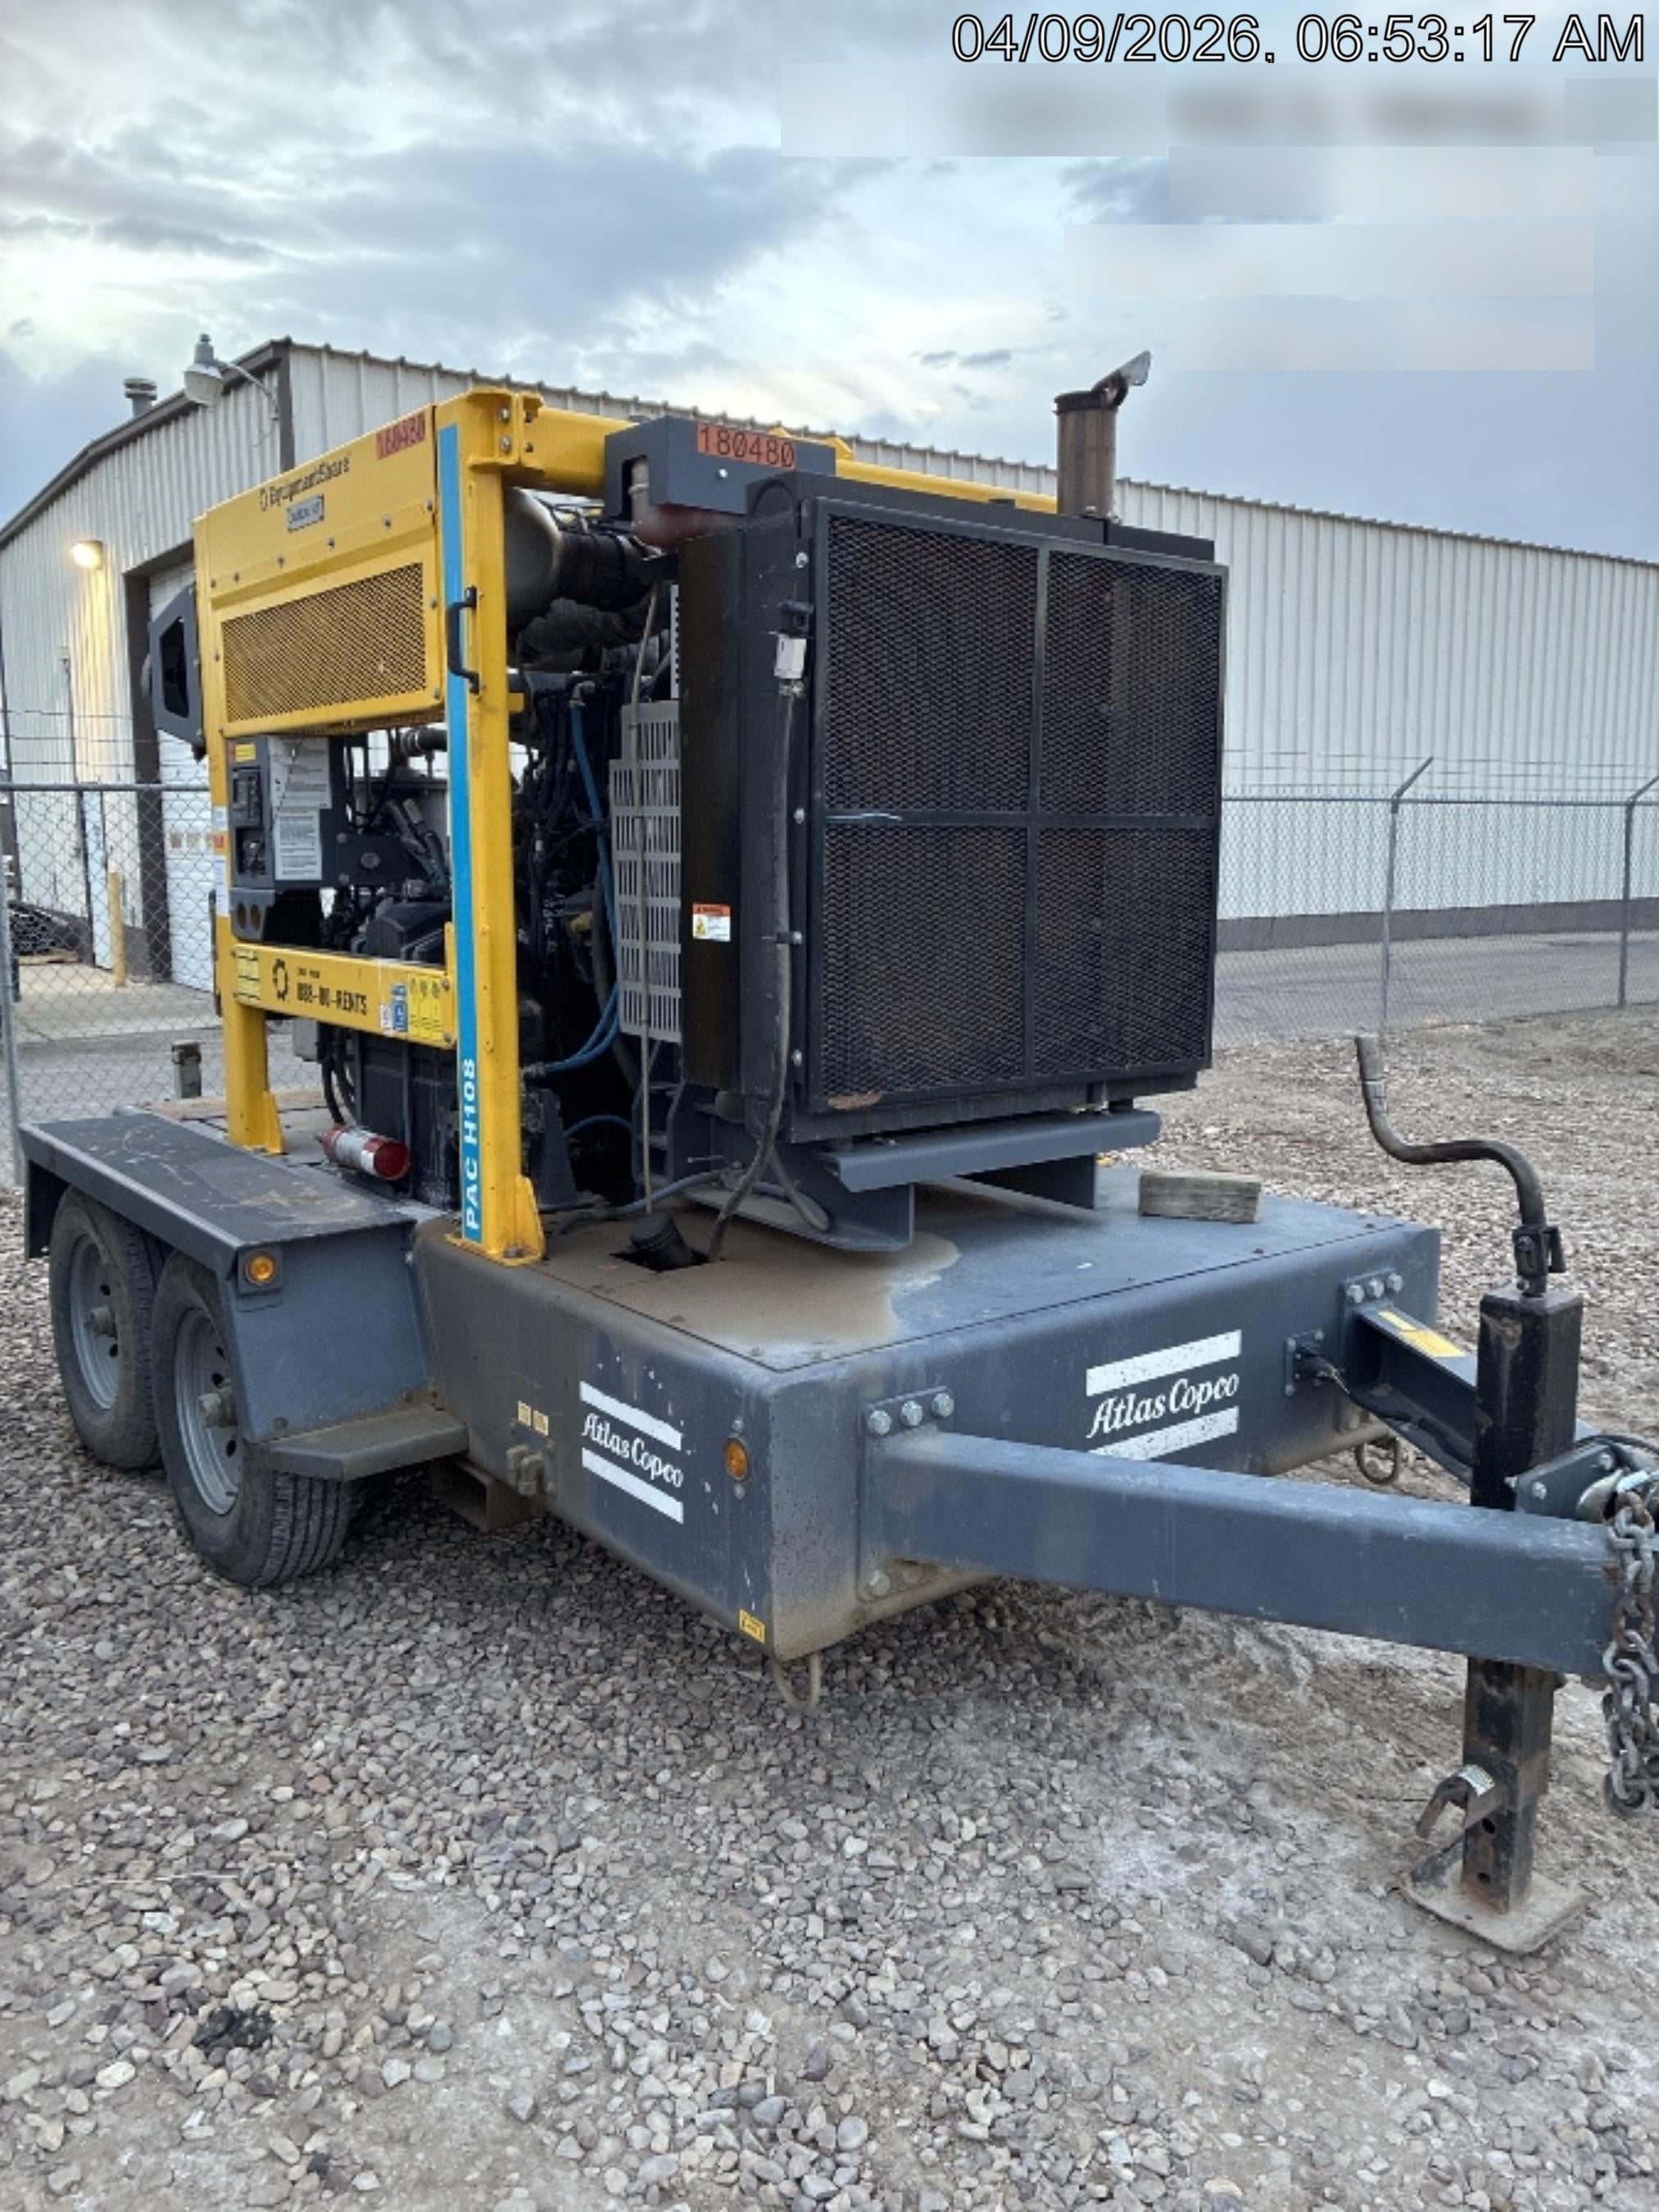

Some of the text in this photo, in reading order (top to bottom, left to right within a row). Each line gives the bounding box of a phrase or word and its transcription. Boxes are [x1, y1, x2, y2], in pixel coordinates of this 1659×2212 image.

[700, 424, 795, 468] 180480
[463, 1058, 480, 1231] PAC H108
[1086, 1372, 1240, 1439] Atlas Copco
[582, 1413, 630, 1458] Atlas
[631, 1437, 683, 1488] Copco
